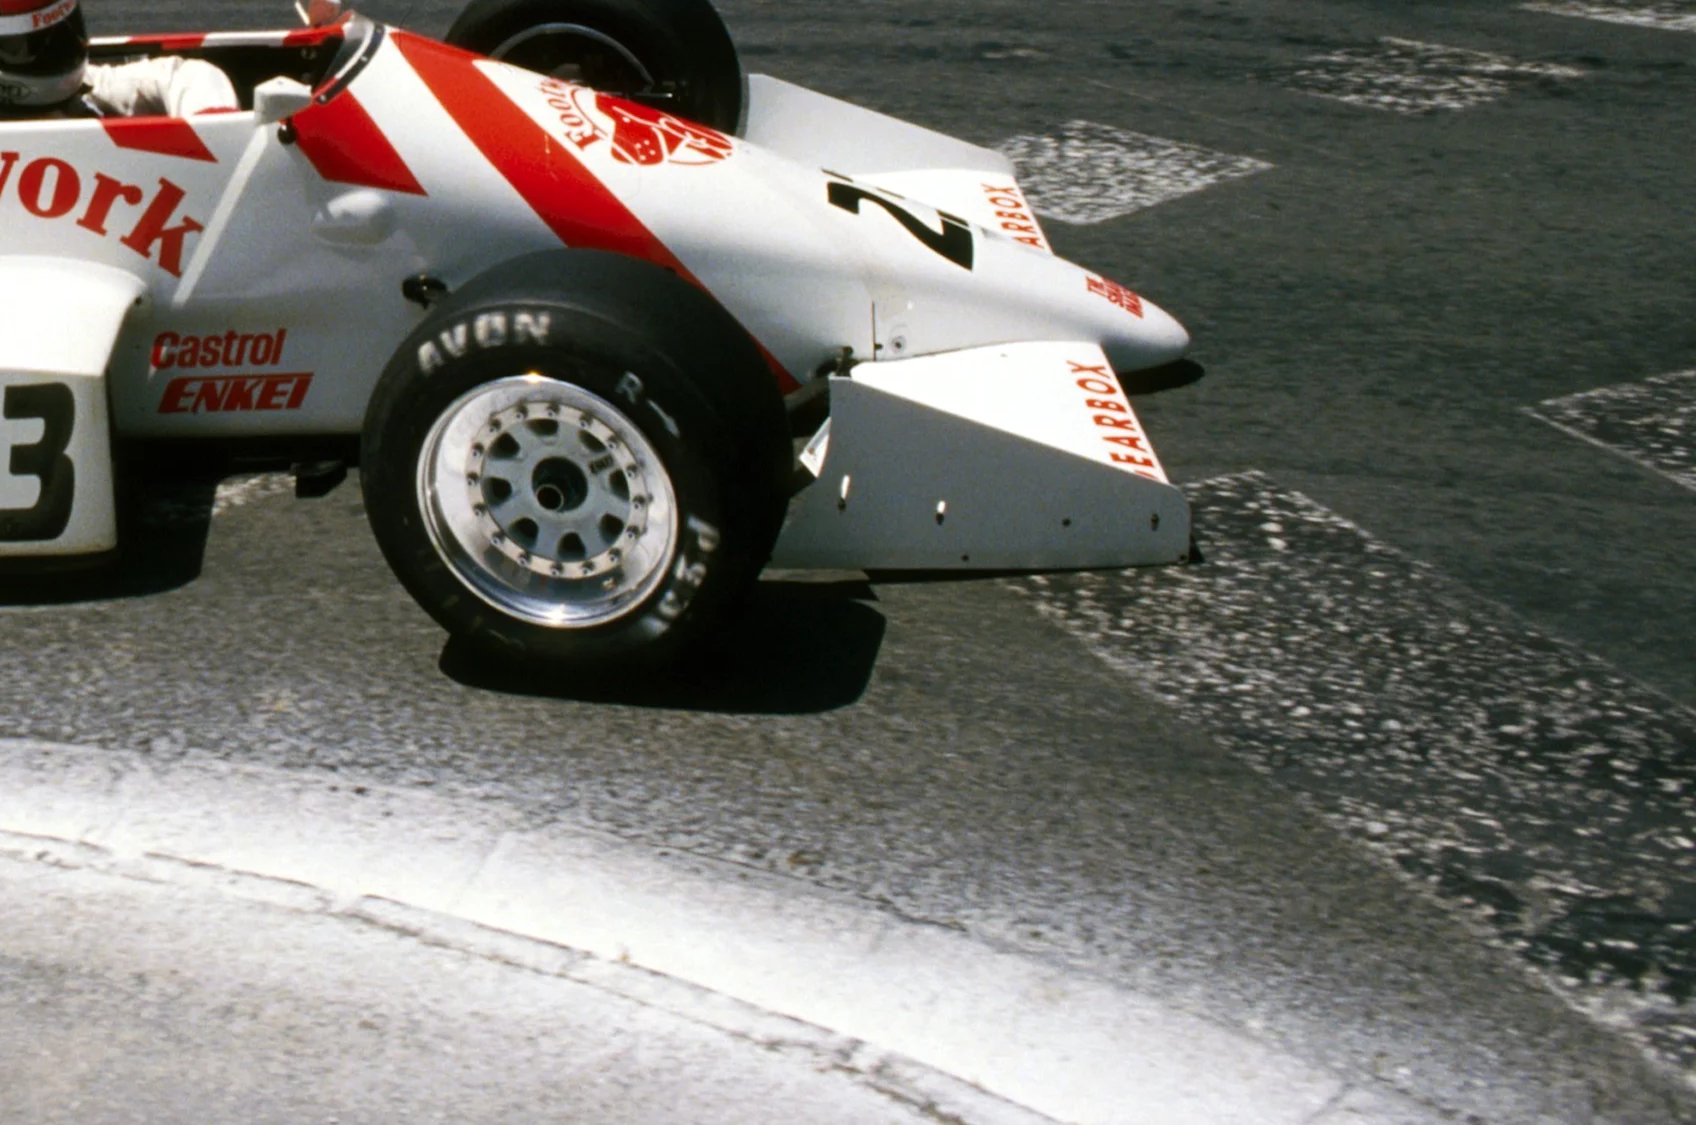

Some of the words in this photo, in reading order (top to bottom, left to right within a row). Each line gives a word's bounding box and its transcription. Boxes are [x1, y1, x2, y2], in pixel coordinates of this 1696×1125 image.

[150, 328, 286, 370] Castrol
[416, 309, 553, 374] AVON
[157, 373, 314, 414] ENKEI
[1066, 360, 1159, 480] EARBOX
